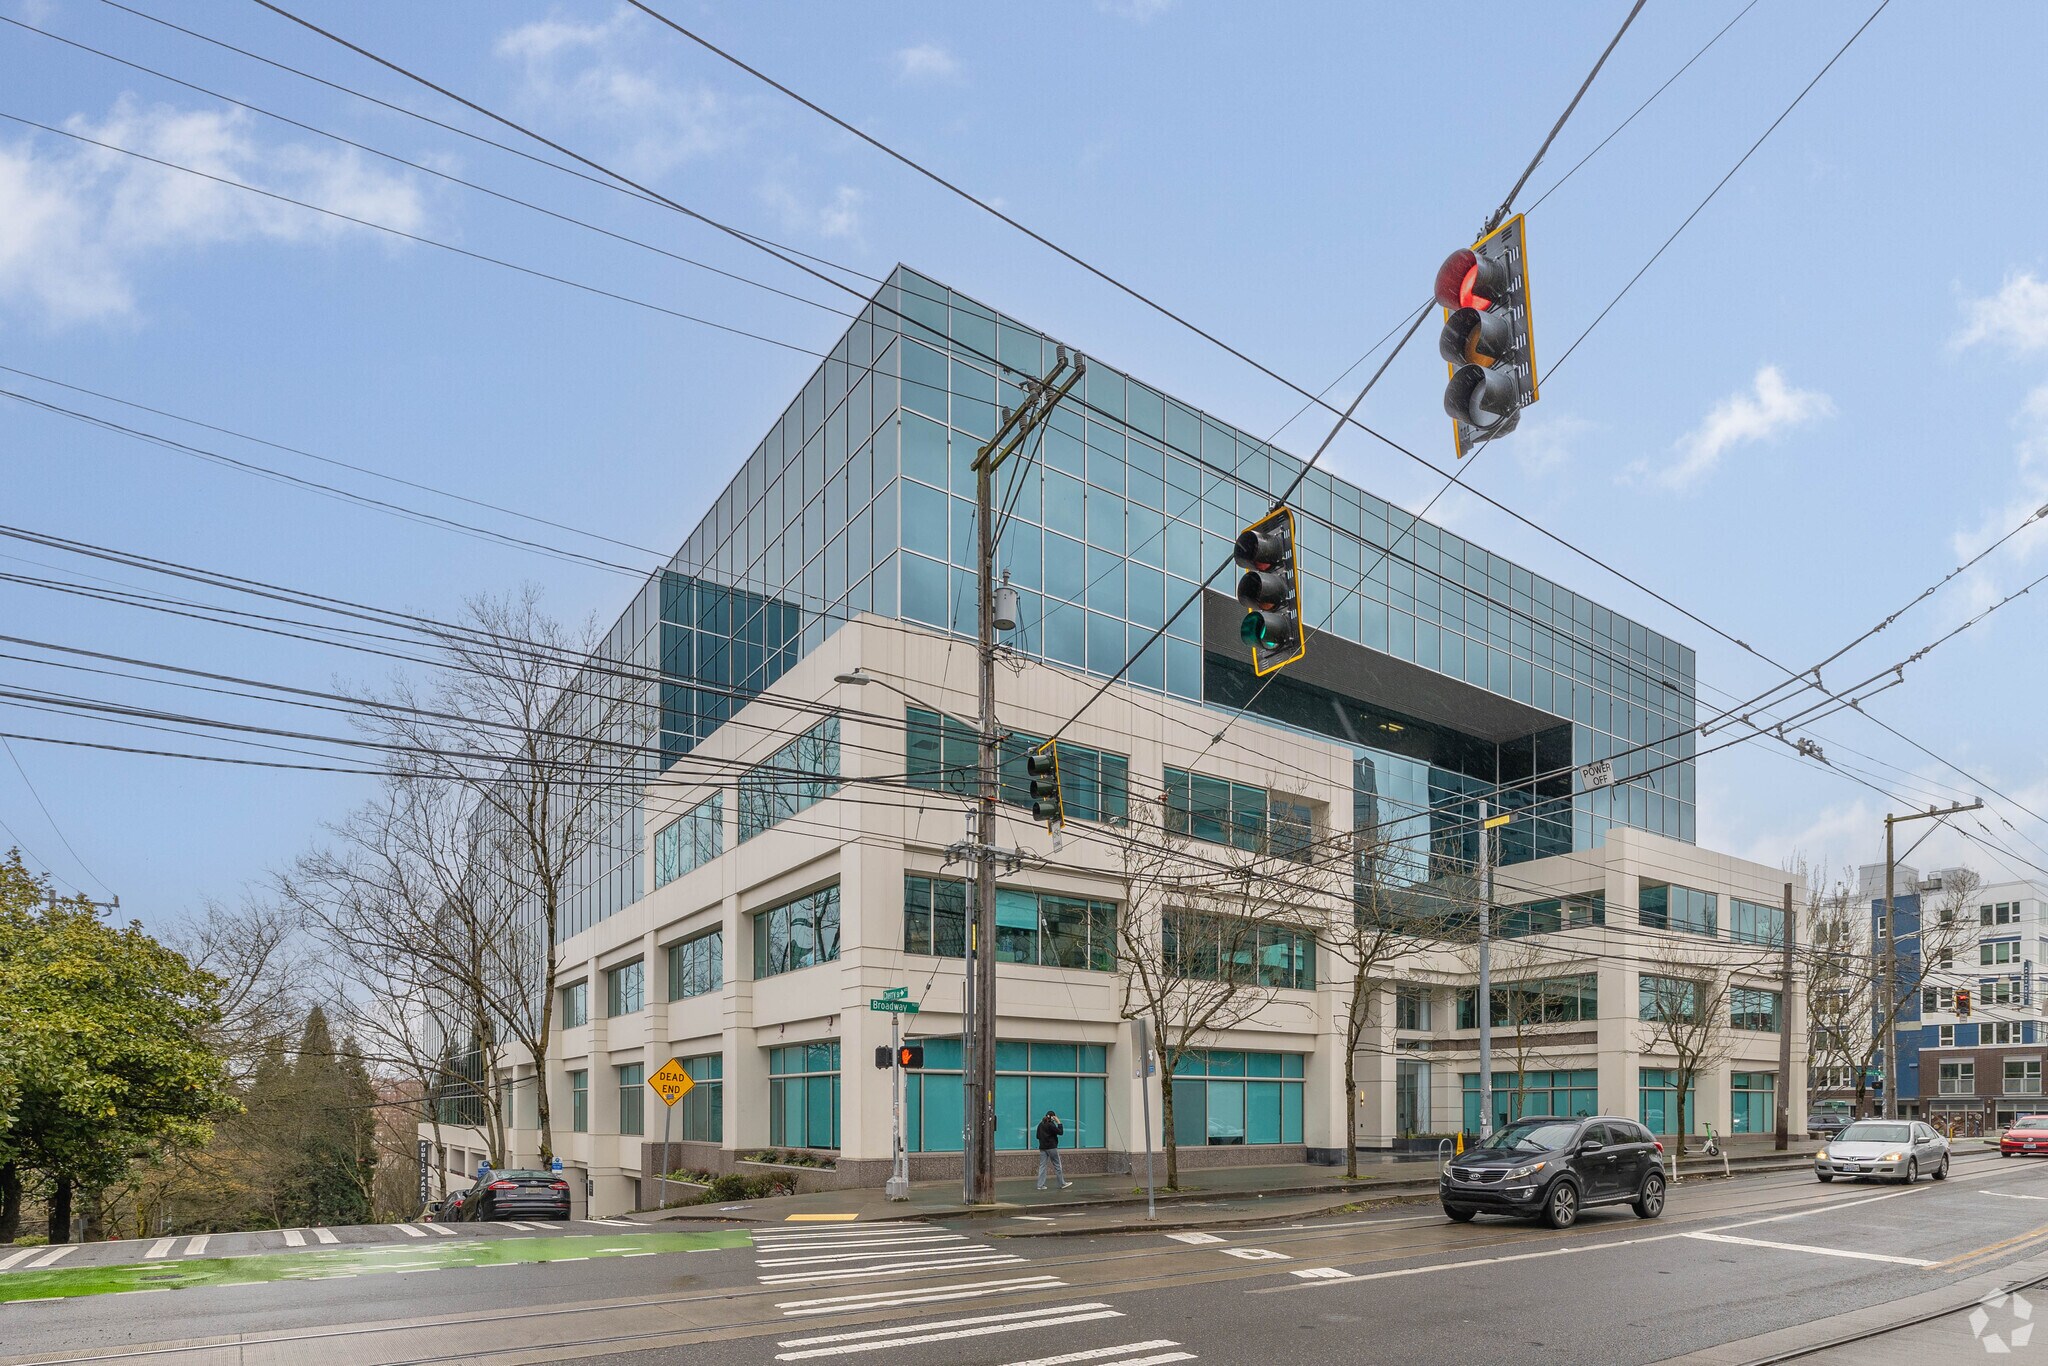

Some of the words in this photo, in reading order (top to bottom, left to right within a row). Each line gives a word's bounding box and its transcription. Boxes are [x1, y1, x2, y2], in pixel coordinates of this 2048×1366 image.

[1583, 763, 1611, 778] POWER
[1593, 775, 1607, 785] OFF
[872, 1001, 907, 1012] Broadway
[660, 1072, 684, 1082] DEAD
[662, 1085, 680, 1093] END
